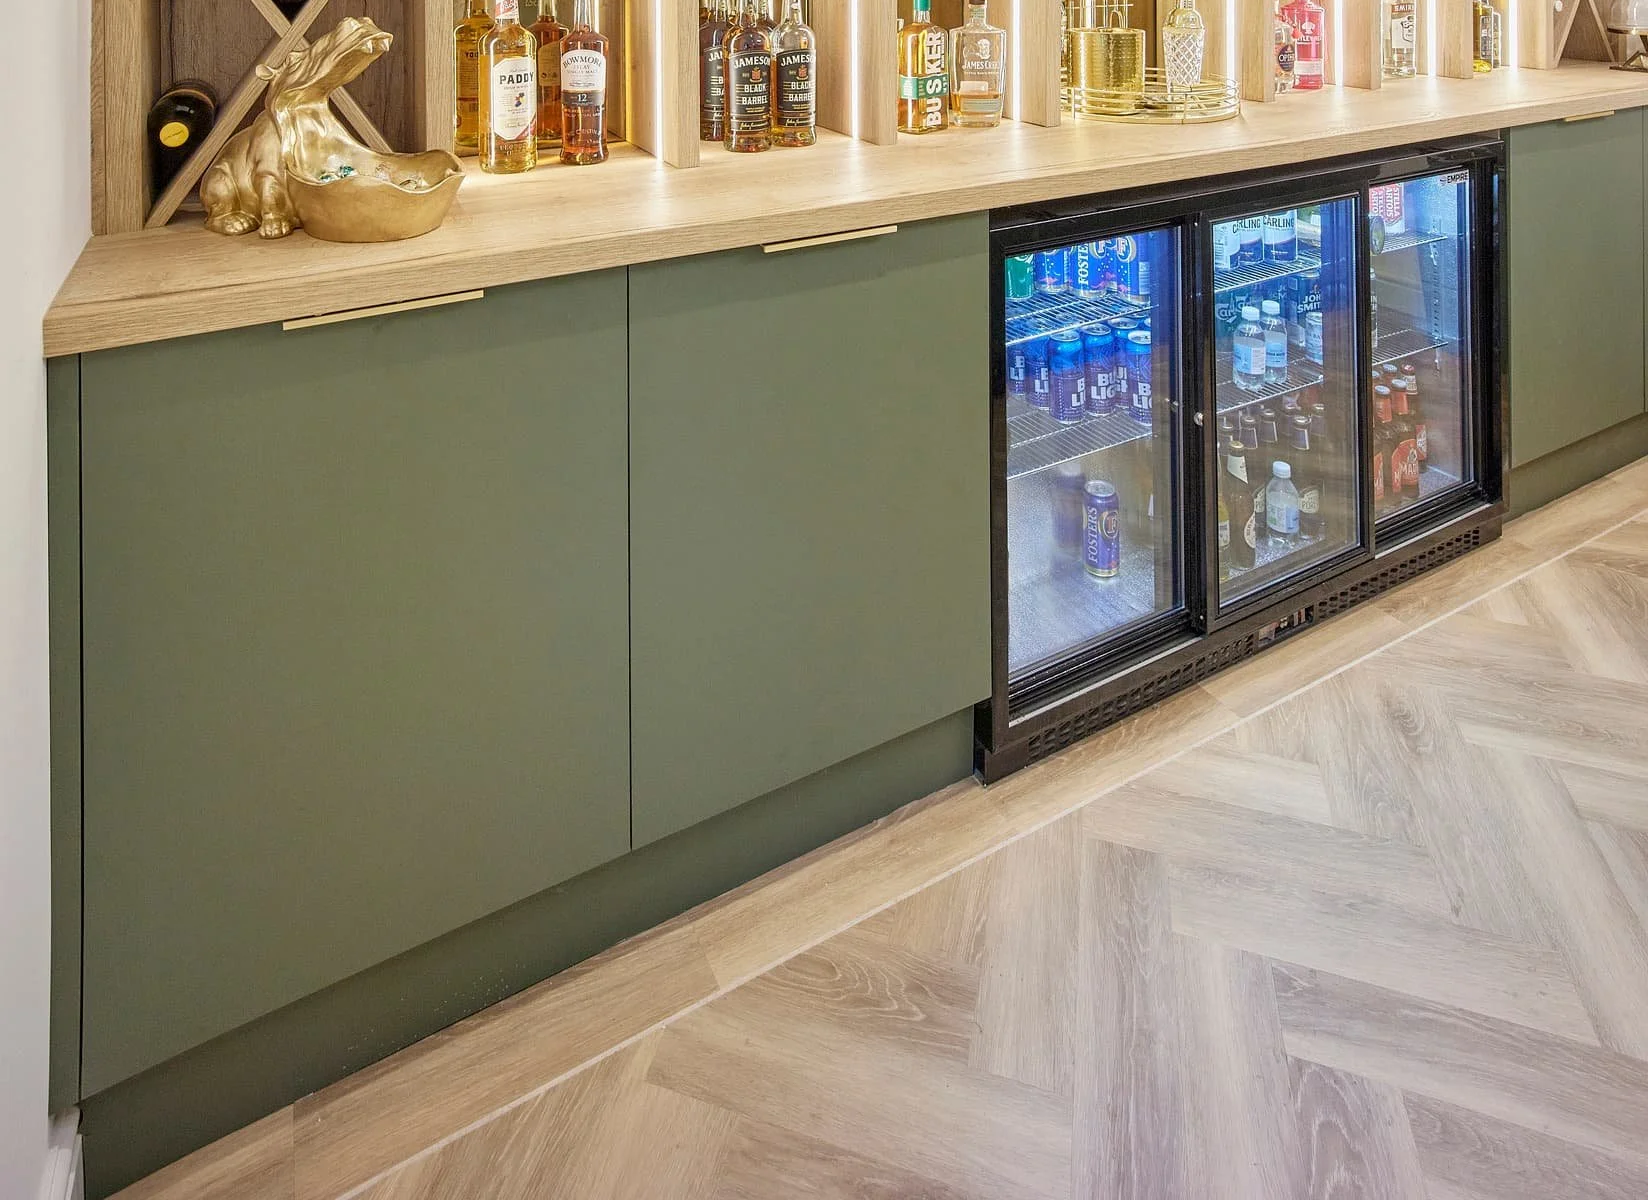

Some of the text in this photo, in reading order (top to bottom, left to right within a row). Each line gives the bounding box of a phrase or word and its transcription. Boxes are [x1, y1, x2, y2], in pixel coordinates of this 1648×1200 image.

[962, 60, 985, 70] JAMES
[500, 71, 534, 85] PADDY
[925, 31, 942, 127] BUSKER
[741, 95, 768, 105] BARREL
[1262, 215, 1295, 228] CARLING
